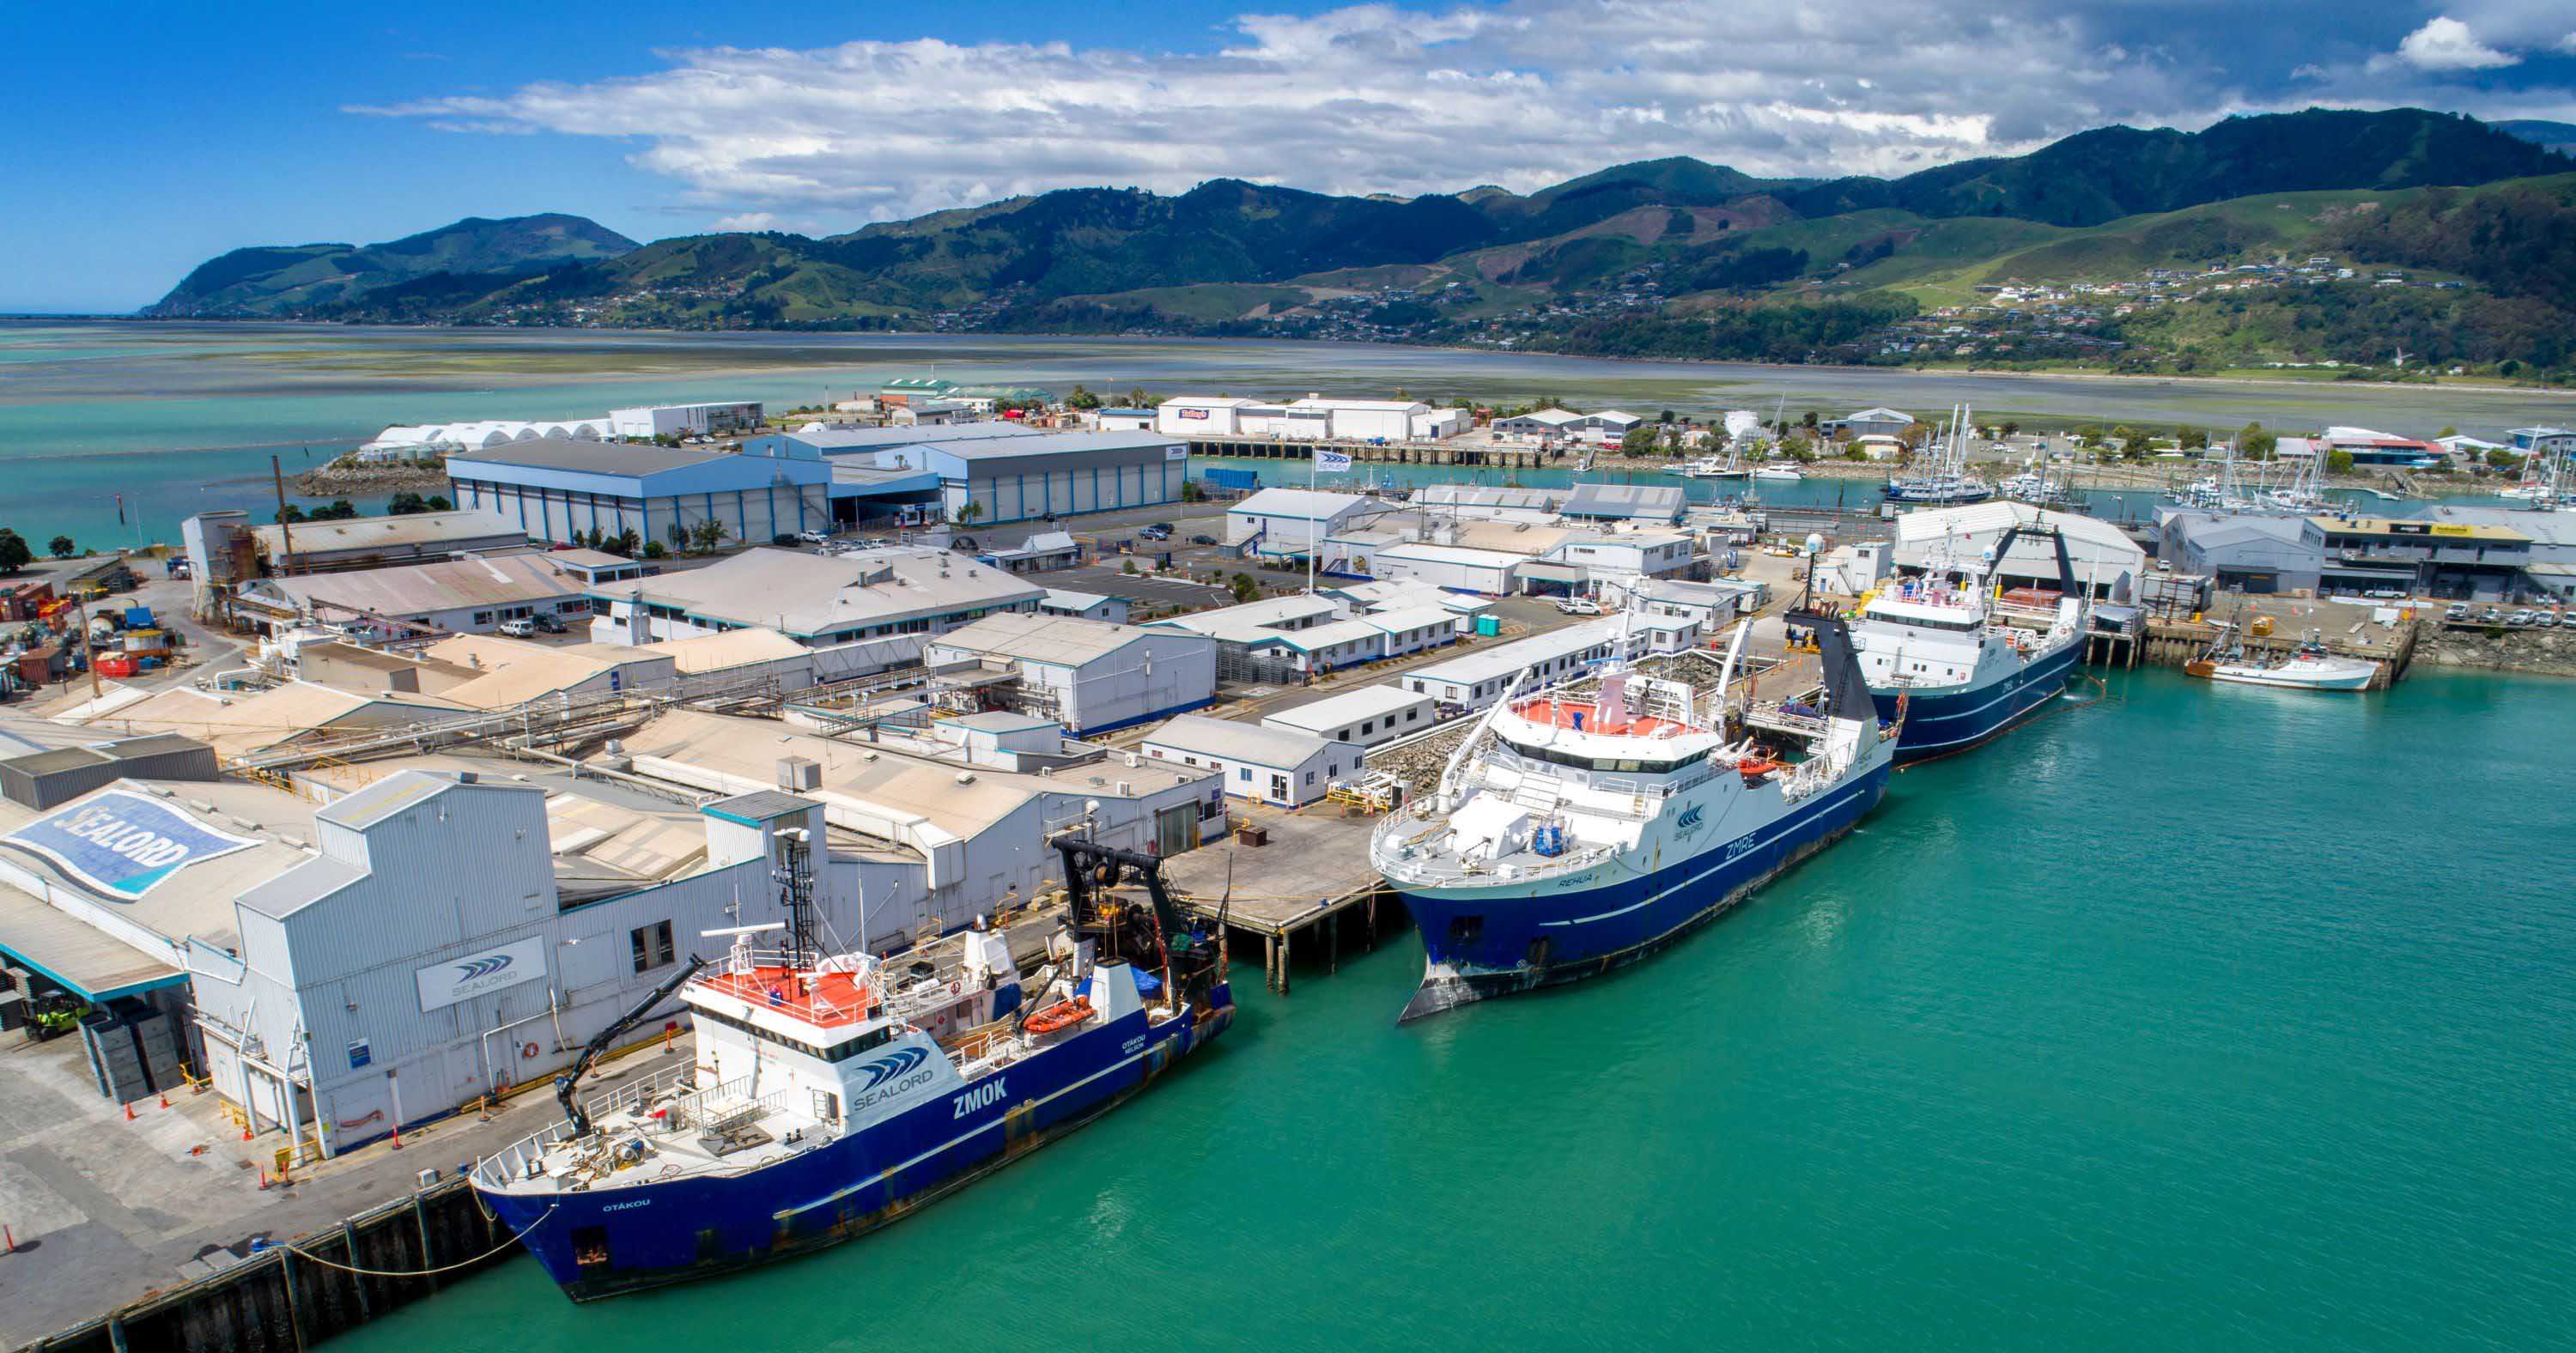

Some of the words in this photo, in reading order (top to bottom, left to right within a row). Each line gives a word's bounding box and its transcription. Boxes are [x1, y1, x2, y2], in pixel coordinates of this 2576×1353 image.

[54, 805, 190, 867] SEALORD
[1674, 822, 1704, 841] SEALORD
[1725, 832, 1756, 859] ZMRE
[1558, 874, 1592, 888] REHUA
[453, 971, 517, 997] SEALORD
[854, 1070, 933, 1112] SEALORD
[953, 1077, 1007, 1119] ZMOK
